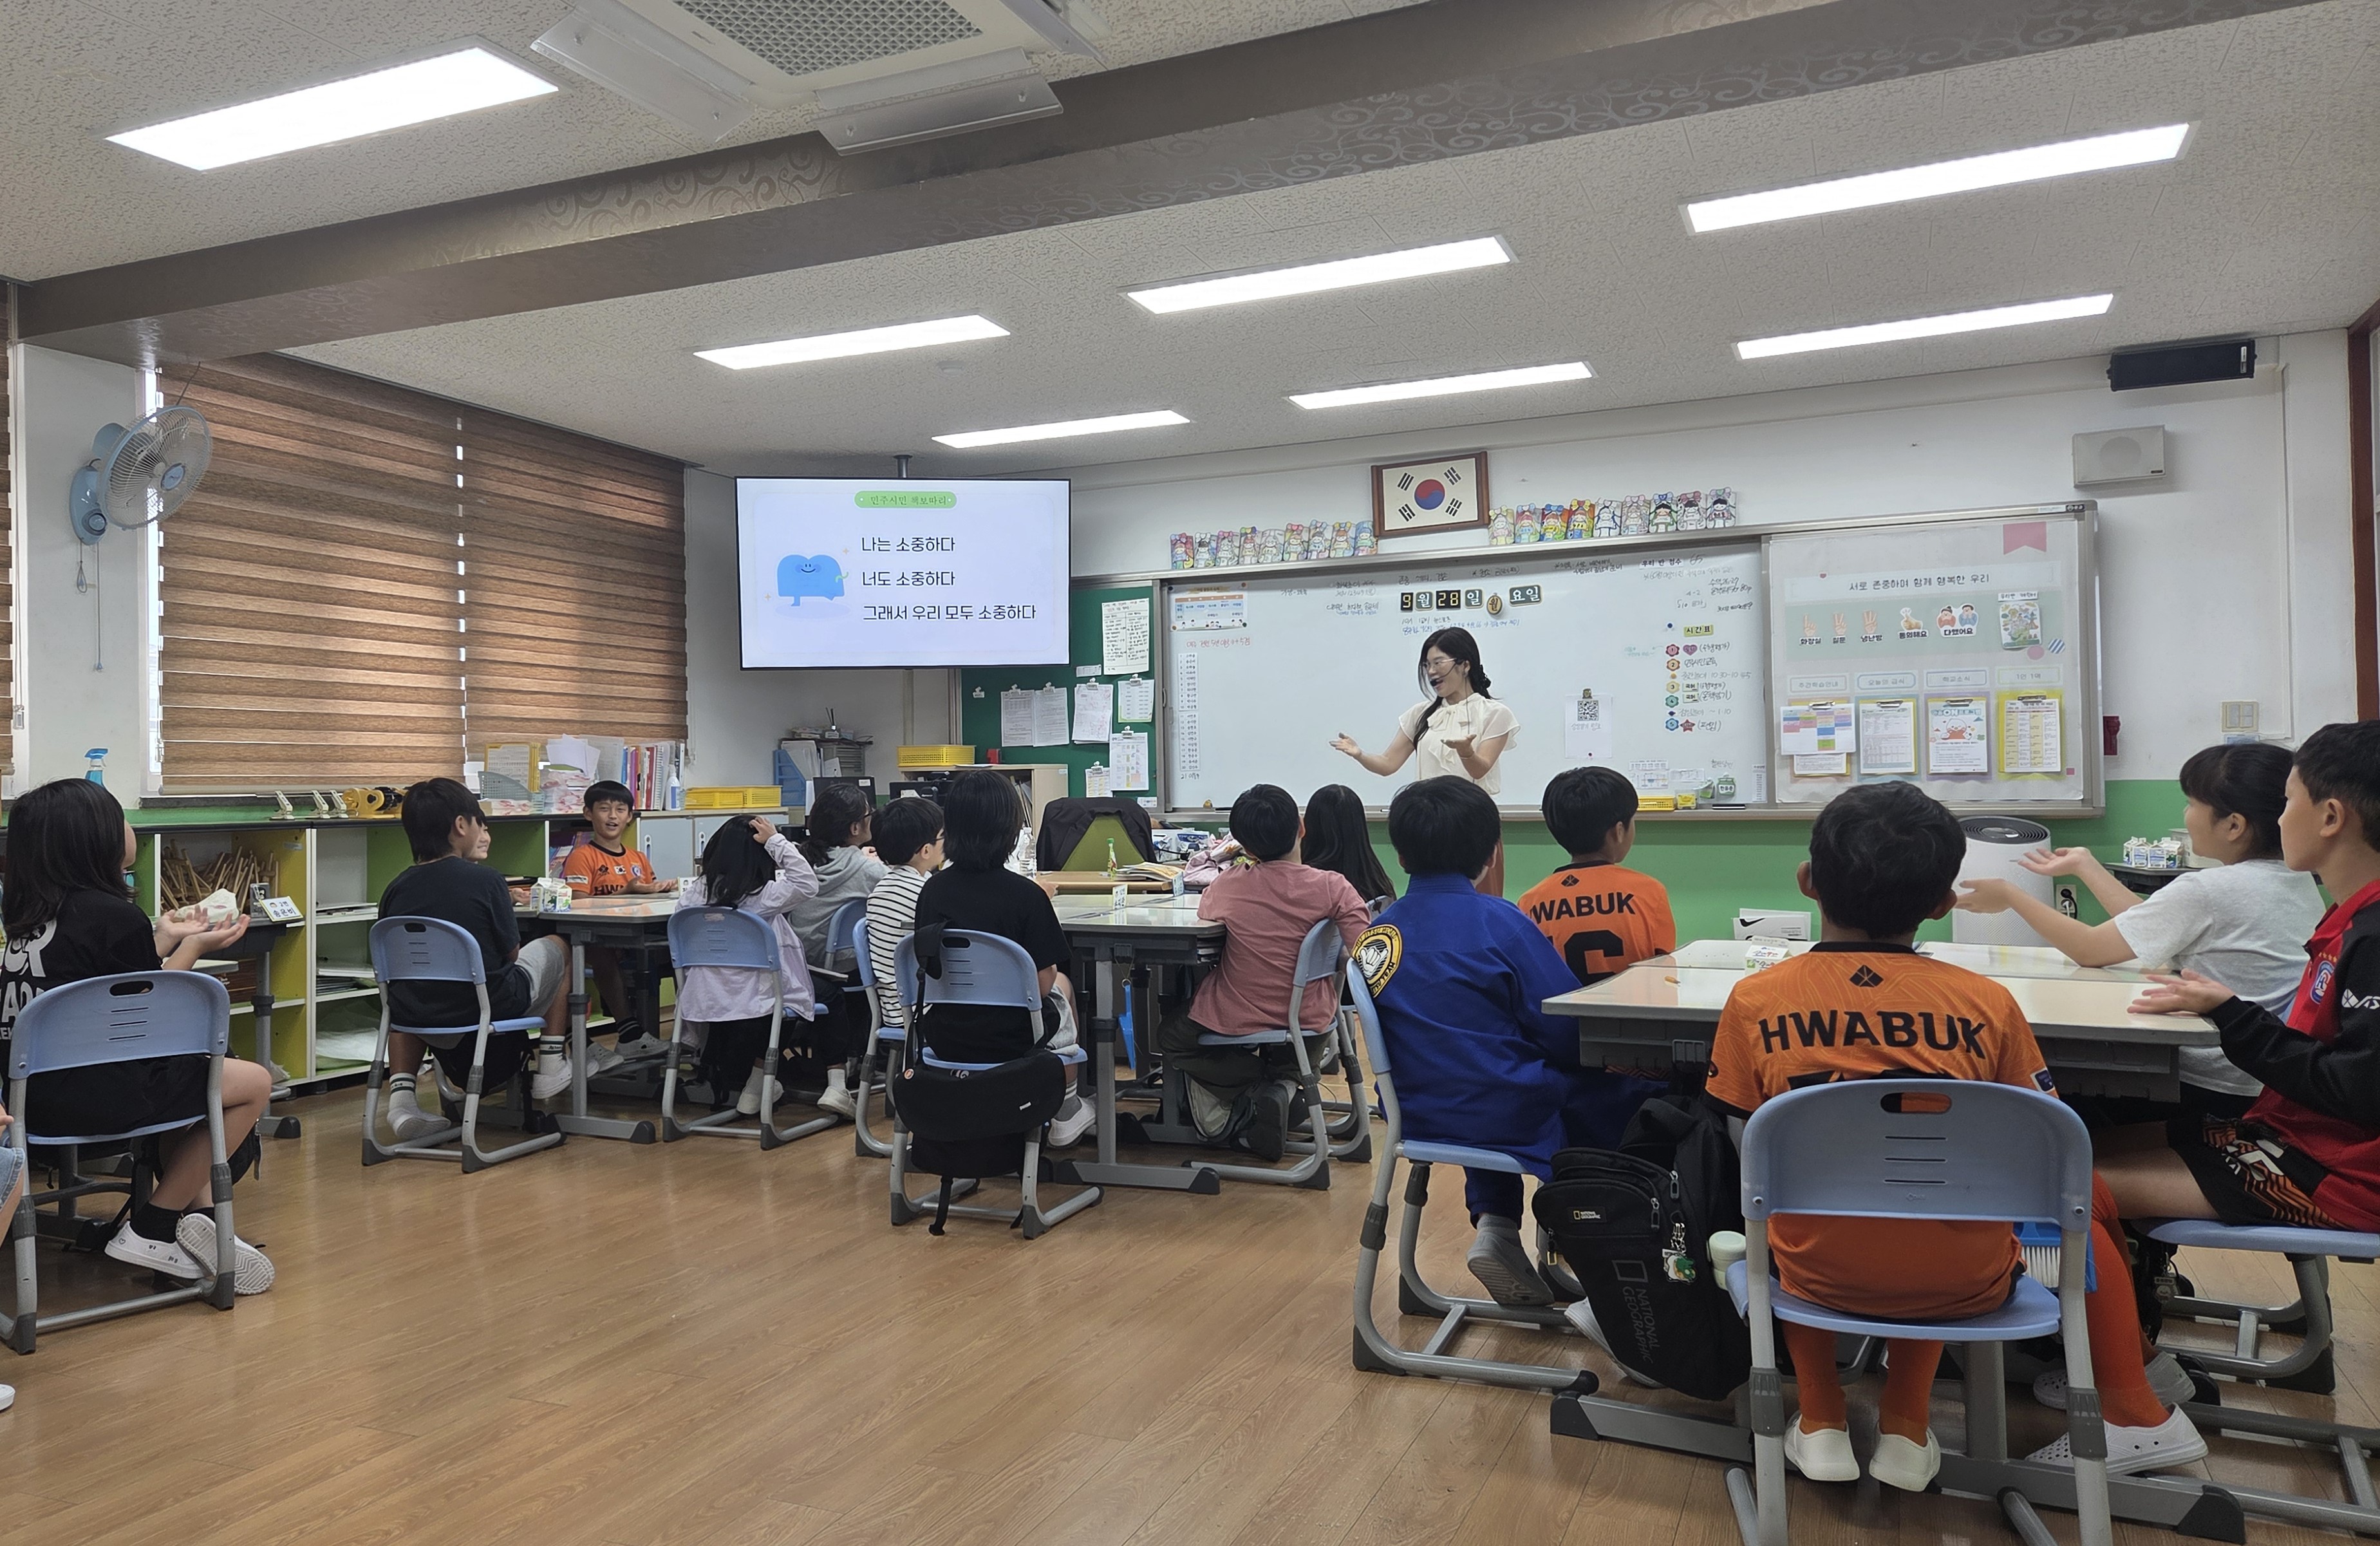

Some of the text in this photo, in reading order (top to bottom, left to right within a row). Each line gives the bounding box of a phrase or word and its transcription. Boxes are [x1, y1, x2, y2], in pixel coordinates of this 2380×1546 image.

[870, 495, 907, 505] 민주시민
[861, 537, 956, 552] 나는 소중하다
[861, 571, 956, 587] 너도 소중하다
[1849, 574, 1989, 591] 서로 존중하며 함께 행복한 우리
[1402, 586, 1541, 612] 9 월 28 일 월 요일
[863, 605, 1036, 621] 그래서 우리 모두 소중하다
[1686, 625, 1710, 634] 시간표
[1898, 630, 1927, 639] 동의해요
[1944, 628, 1974, 636] 다했어요
[1526, 892, 1636, 925] WABUK
[1759, 1010, 1986, 1059] HWABUK
[1622, 1287, 1654, 1364] GEOGRAPHIC
[1635, 1288, 1660, 1350] NATIONAL
